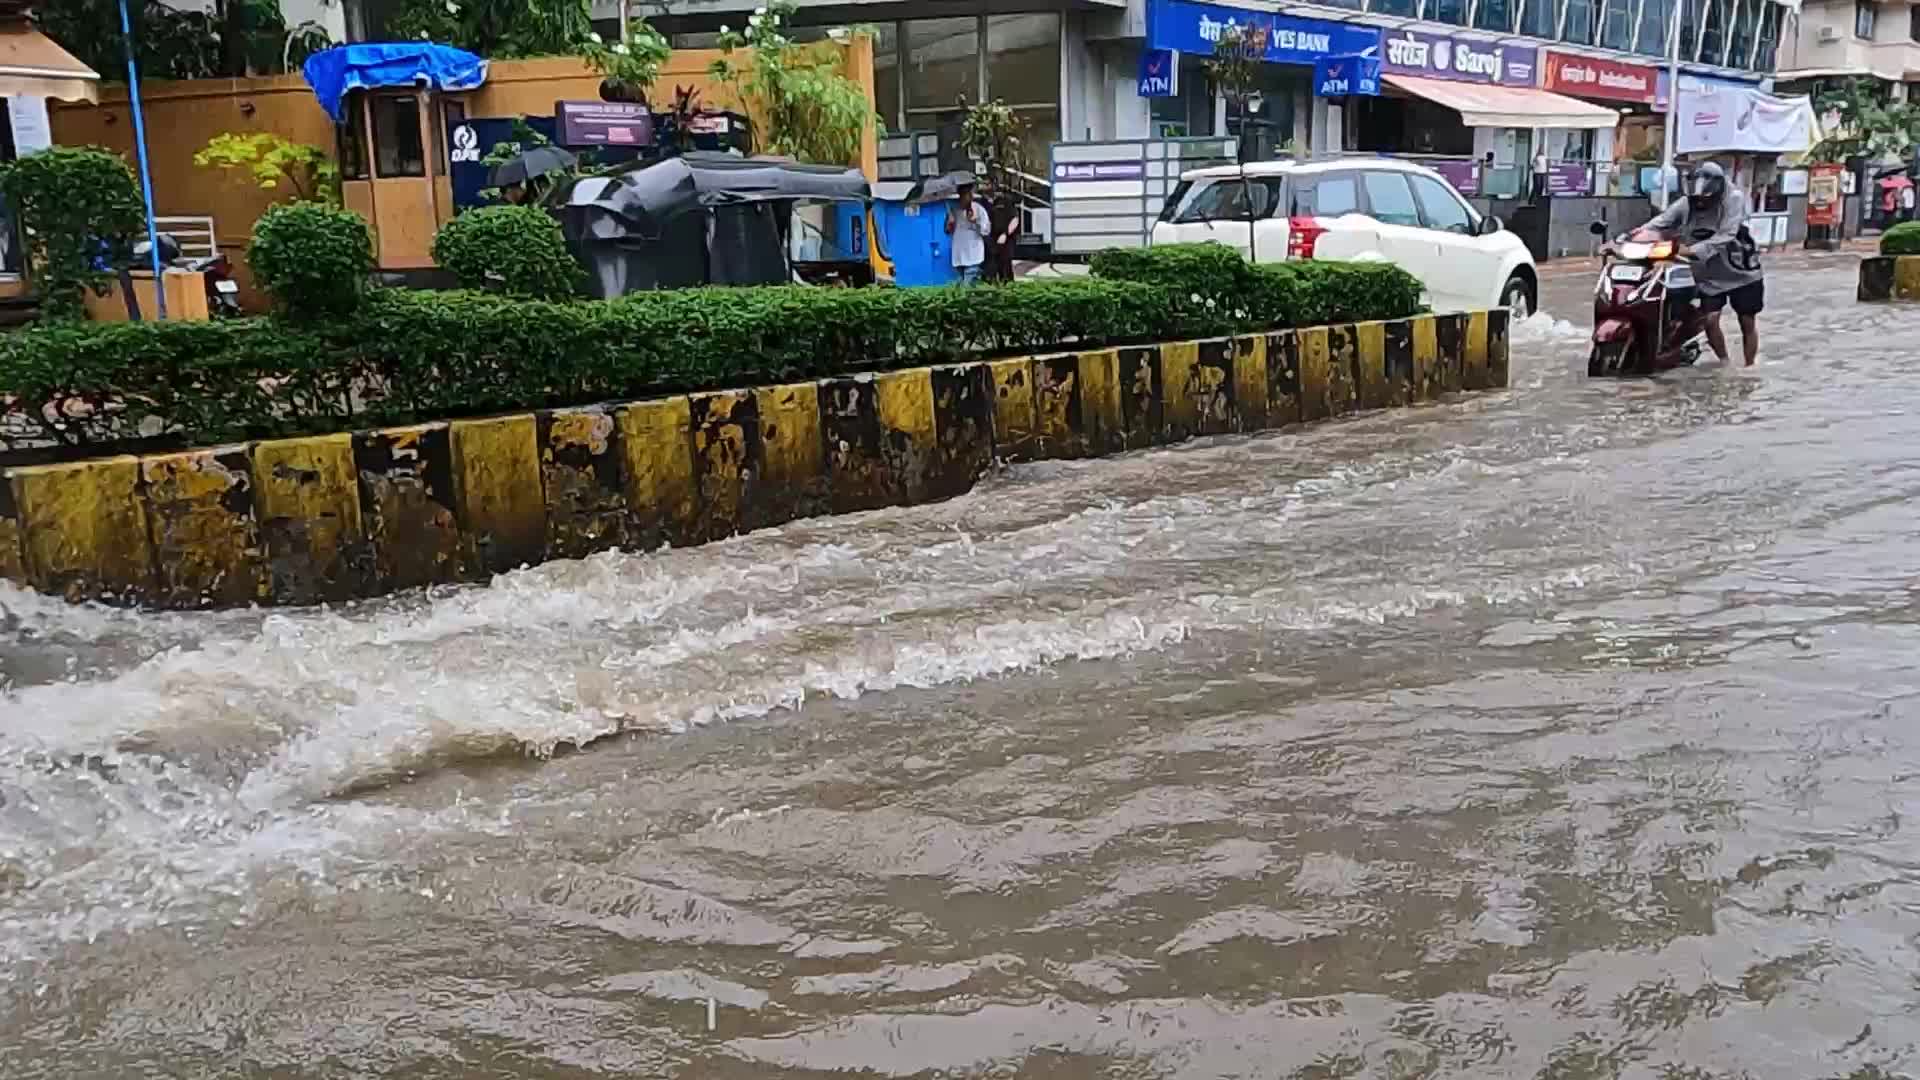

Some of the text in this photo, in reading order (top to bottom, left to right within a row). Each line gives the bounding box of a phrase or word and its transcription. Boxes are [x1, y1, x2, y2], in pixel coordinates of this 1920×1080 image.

[1272, 29, 1295, 49] YES
[1299, 32, 1331, 51] BANK
[1387, 32, 1429, 67] सरोज
[1456, 44, 1503, 82] Saroj
[1141, 77, 1168, 94] ATM
[1321, 78, 1348, 94] ATM
